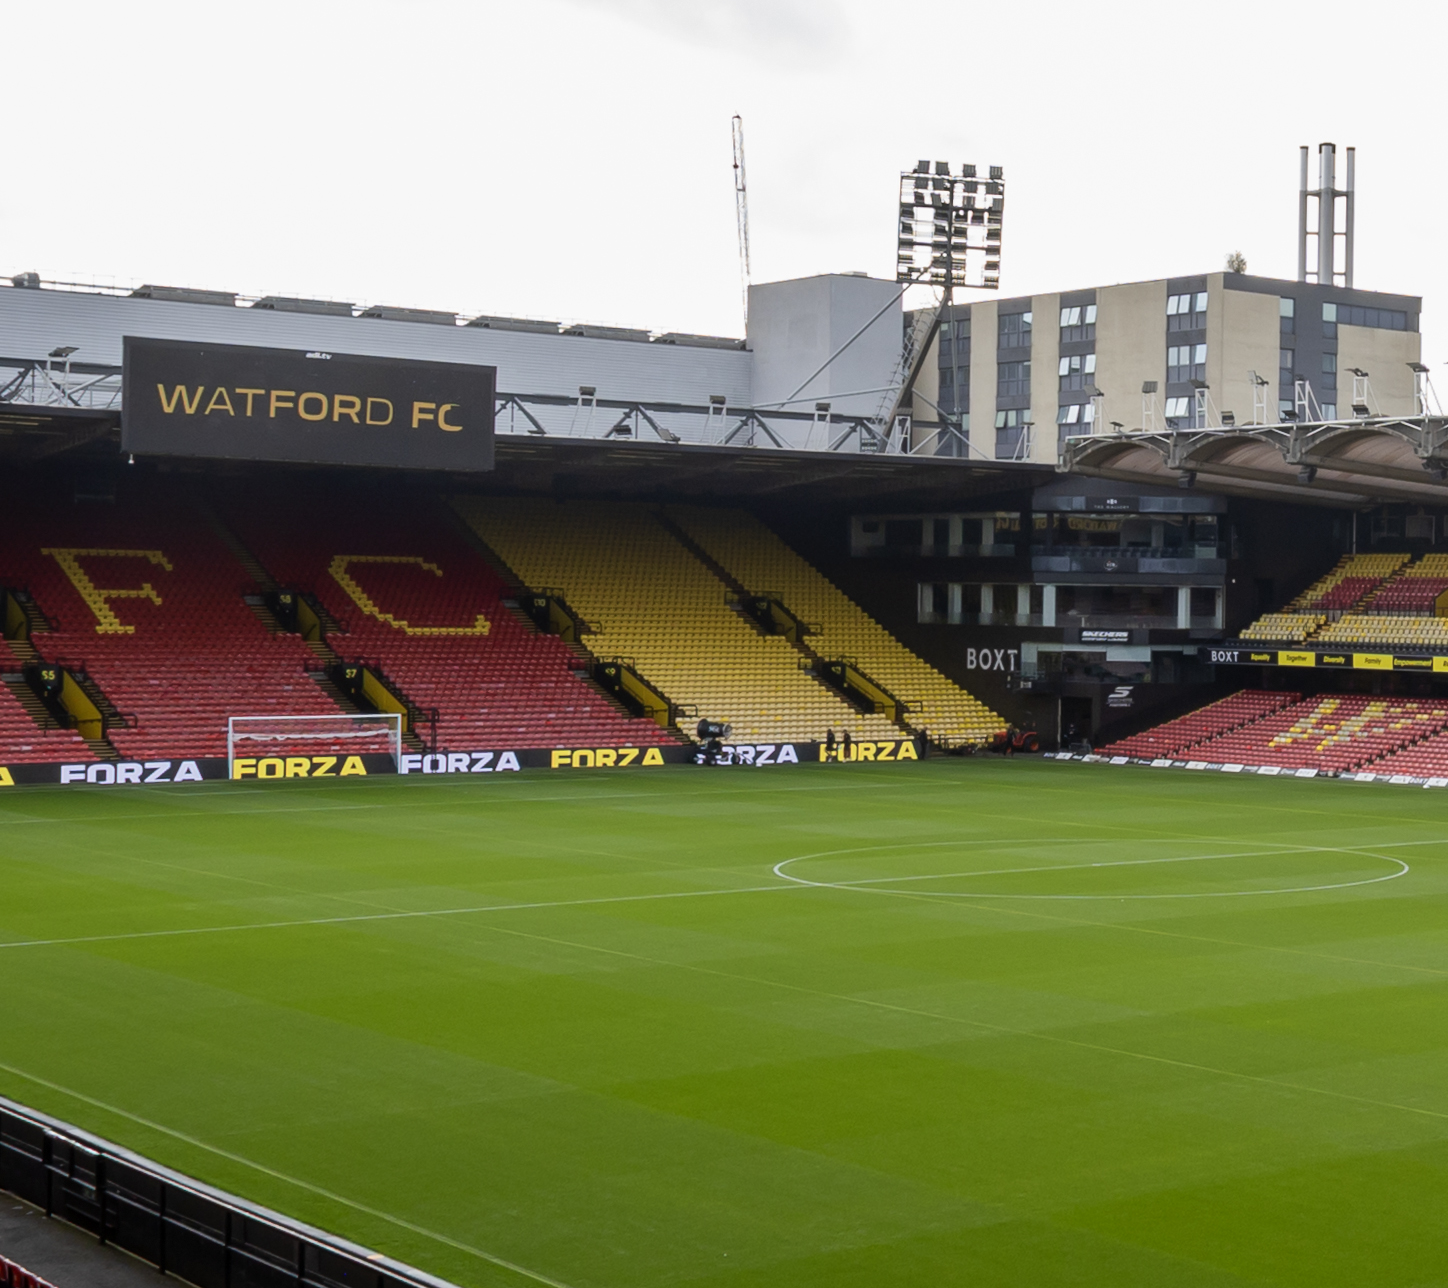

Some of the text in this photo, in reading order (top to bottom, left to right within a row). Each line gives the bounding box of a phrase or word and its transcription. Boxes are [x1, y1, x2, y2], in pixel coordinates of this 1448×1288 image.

[157, 383, 463, 432] WATFORD FC
[967, 647, 1018, 672] BOXT
[1211, 651, 1239, 662] BOXT
[1286, 652, 1307, 663] Together
[41, 670, 55, 680] S5
[345, 668, 357, 678] S7
[60, 760, 204, 784] FORZA
[232, 755, 368, 779] FORZA
[401, 751, 521, 774] FORZA
[550, 748, 665, 769] FORZA
[702, 744, 799, 766] ORZA
